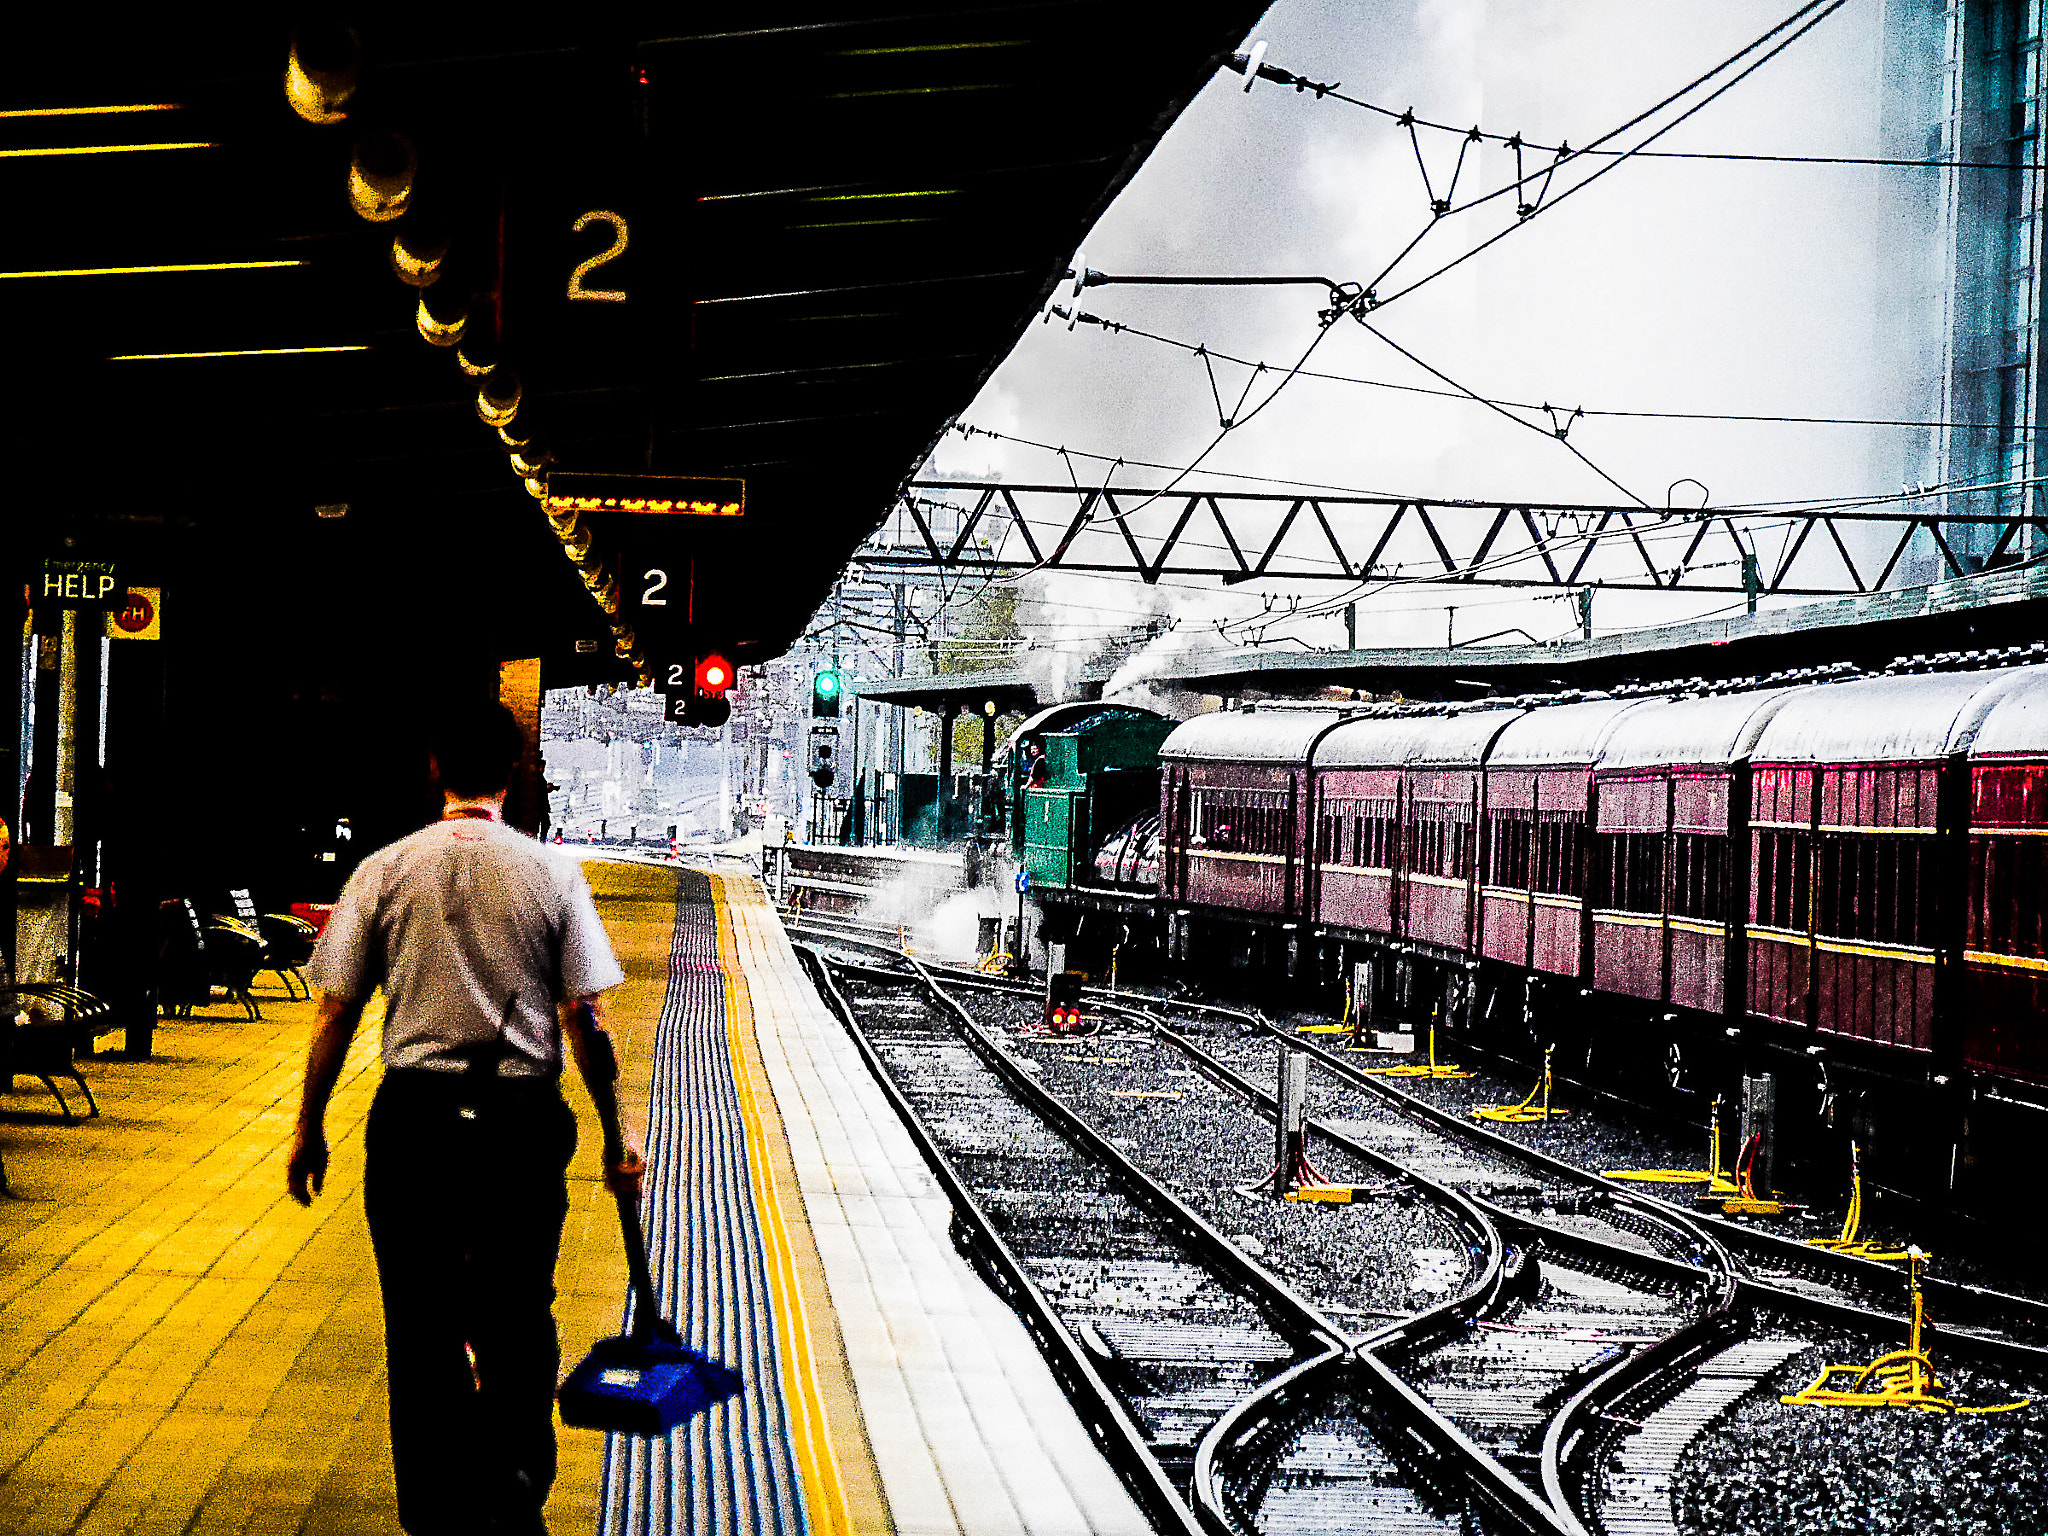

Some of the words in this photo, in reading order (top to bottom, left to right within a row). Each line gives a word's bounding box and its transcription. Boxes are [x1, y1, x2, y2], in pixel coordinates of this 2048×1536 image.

[567, 210, 628, 302] 2
[43, 573, 115, 599] HELP
[641, 569, 668, 606] 2
[667, 664, 684, 686] 2
[674, 699, 686, 715] 2
